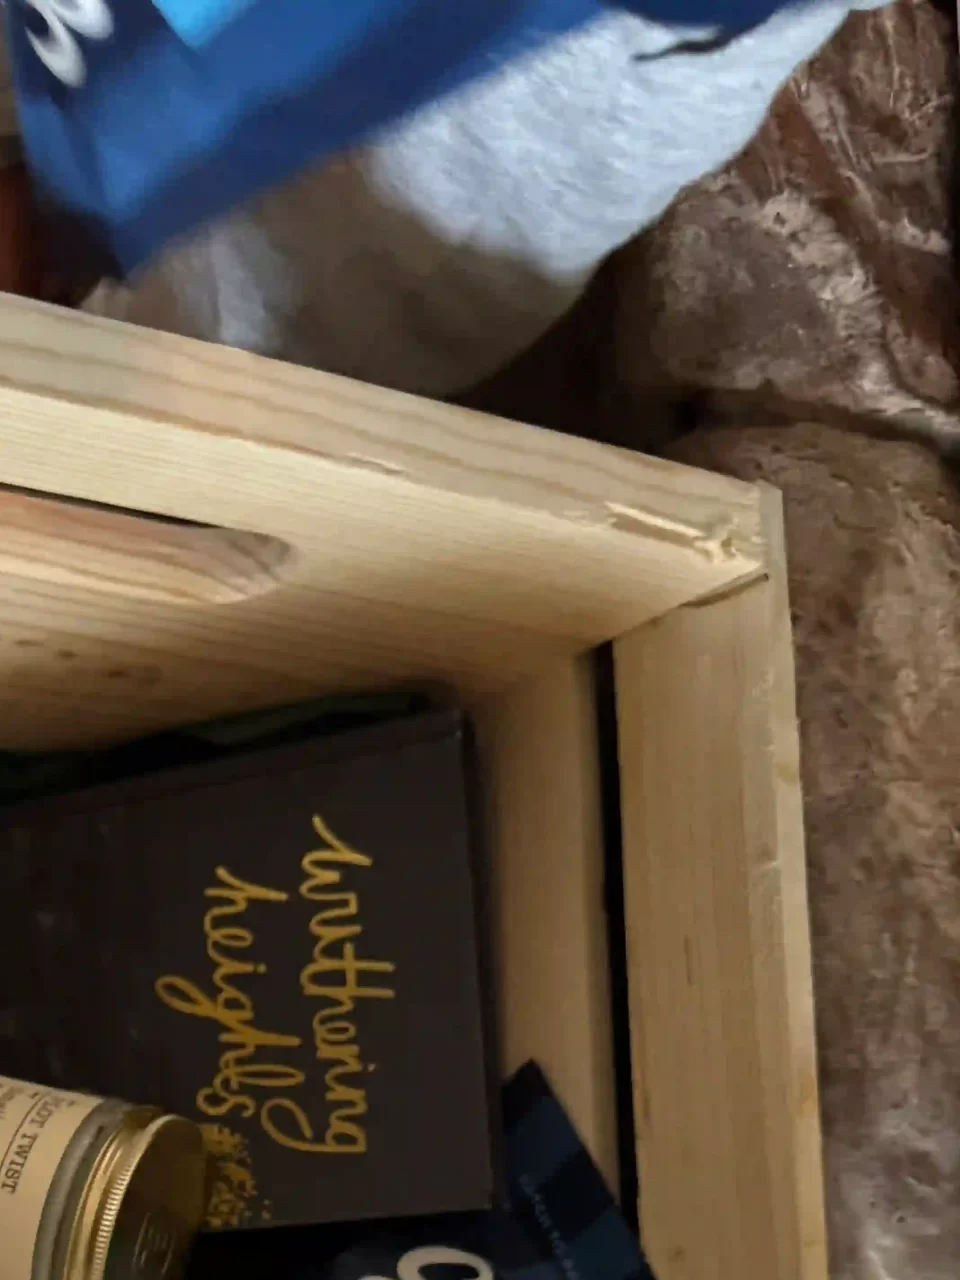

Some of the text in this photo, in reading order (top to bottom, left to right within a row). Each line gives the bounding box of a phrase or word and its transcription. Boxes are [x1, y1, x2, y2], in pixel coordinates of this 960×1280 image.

[155, 865, 306, 1118] heights
[260, 813, 397, 1155] wuthering
[0, 1132, 40, 1195] TWIST
